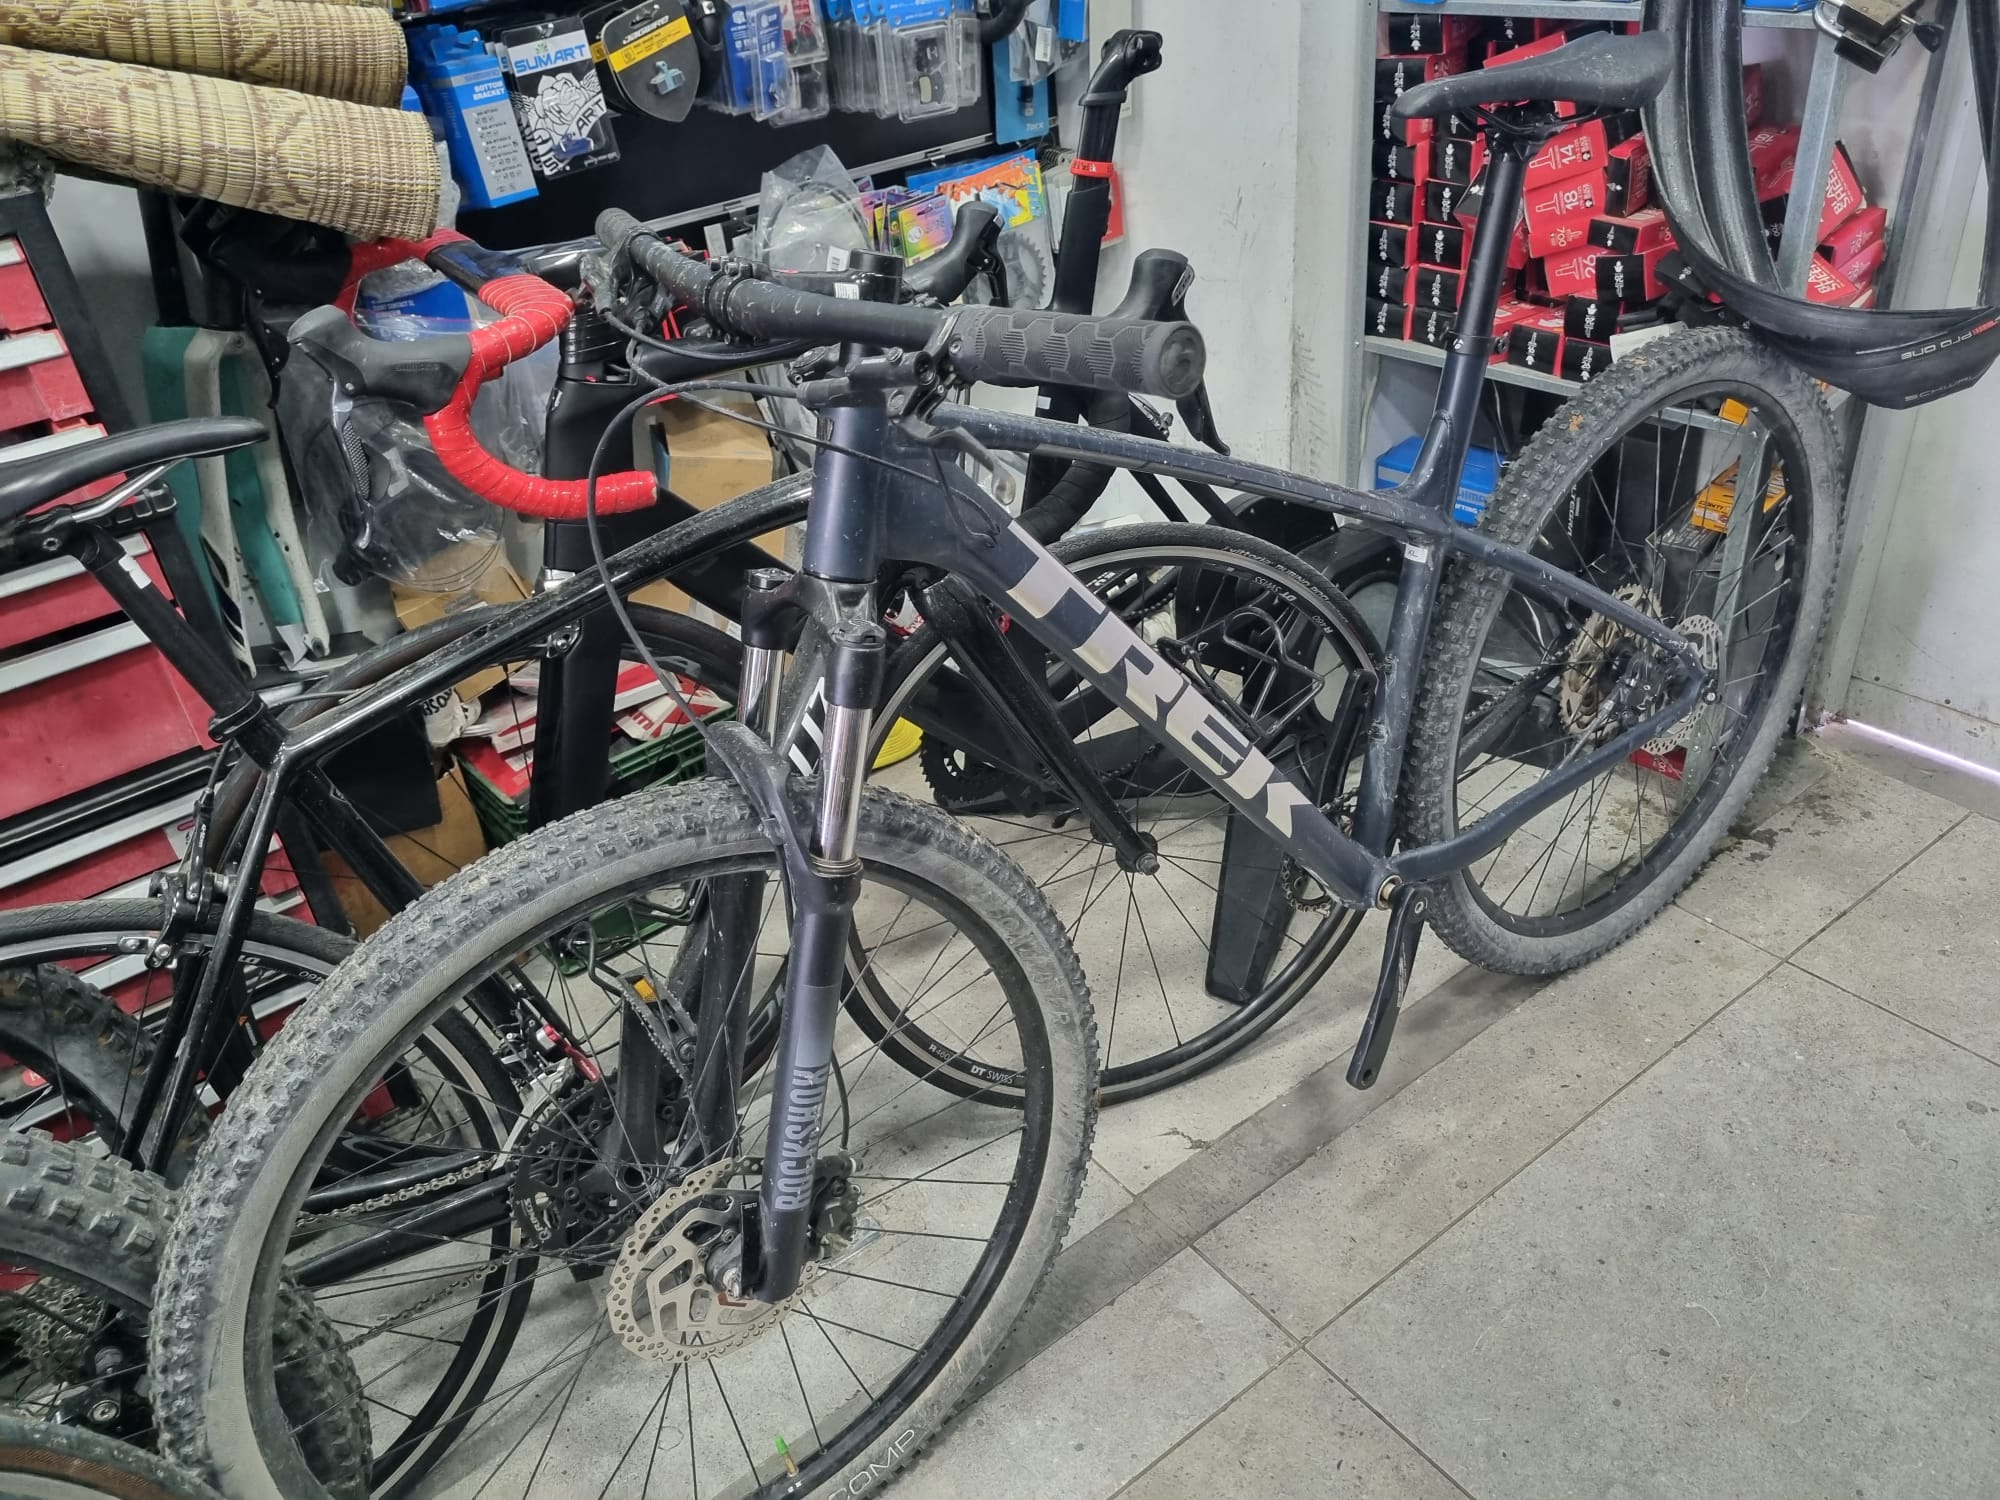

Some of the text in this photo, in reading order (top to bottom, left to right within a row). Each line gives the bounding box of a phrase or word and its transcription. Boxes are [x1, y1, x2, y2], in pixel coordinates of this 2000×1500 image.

[514, 44, 586, 73] SUMART
[575, 98, 606, 136] ART
[1560, 144, 1577, 165] 14
[1563, 190, 1580, 210] 18
[1567, 484, 1578, 537] LTEGRA
[1254, 576, 1298, 602] DT SWISS
[1006, 520, 1312, 839] TREK
[970, 1064, 1014, 1084] DT SWISS
[774, 1064, 831, 1211] ROCKSHOX
